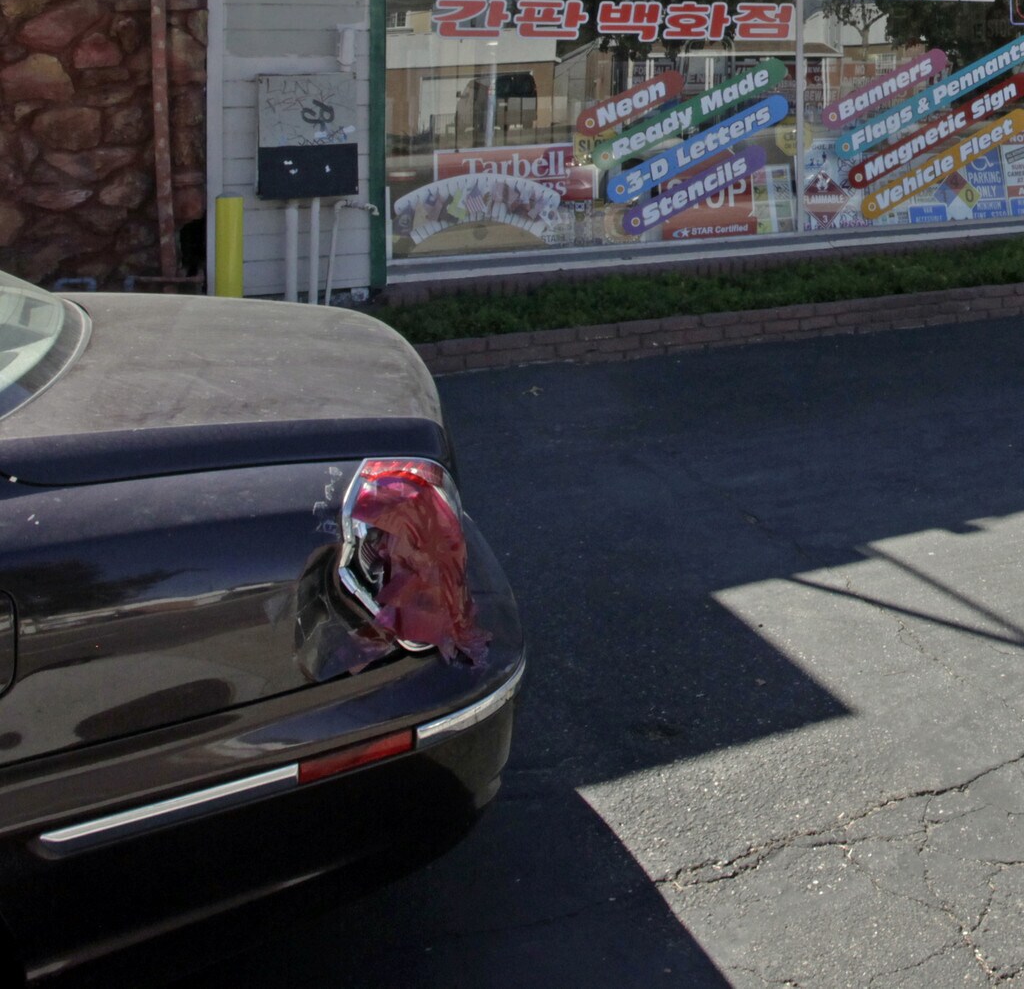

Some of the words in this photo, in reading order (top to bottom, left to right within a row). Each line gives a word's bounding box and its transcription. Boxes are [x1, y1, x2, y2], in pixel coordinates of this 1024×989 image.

[596, 80, 666, 128] Neon
[611, 106, 693, 161] Ready
[700, 68, 769, 116] Made
[838, 57, 933, 121] Banners
[850, 105, 913, 151] Flags
[917, 97, 930, 115] &
[864, 110, 966, 181] Magnetic
[971, 82, 1017, 120] Sign
[625, 157, 669, 195] 3-D
[676, 105, 771, 167] Letters
[875, 155, 954, 210] Vehicle
[959, 118, 1014, 162] Fleet
[641, 156, 748, 227] Stencils
[803, 194, 845, 205] FLAMMABLE
[965, 189, 974, 203] 0
[968, 171, 1001, 184] PARKING
[977, 185, 997, 198] ONLY
[691, 226, 714, 235] STAR
[715, 224, 748, 234] Certified
[822, 215, 829, 224] 3
